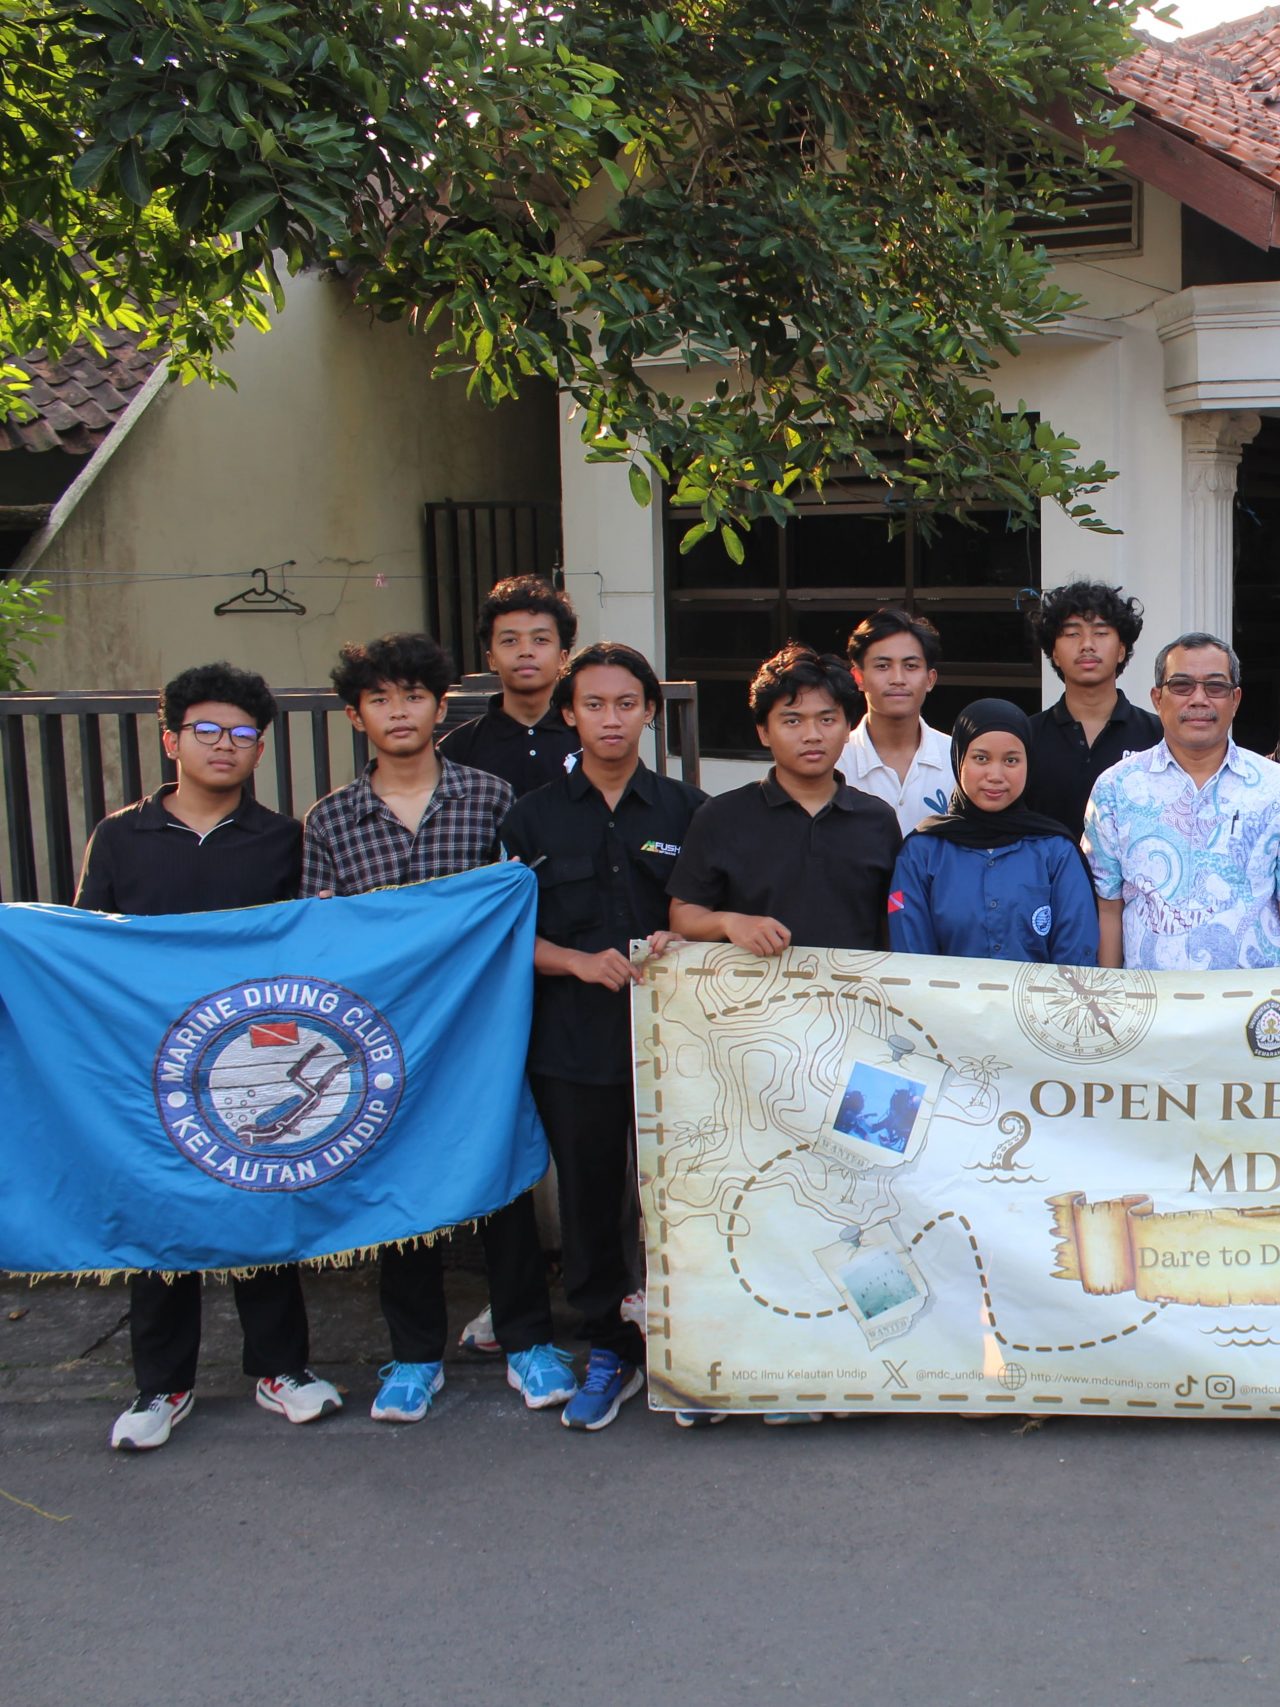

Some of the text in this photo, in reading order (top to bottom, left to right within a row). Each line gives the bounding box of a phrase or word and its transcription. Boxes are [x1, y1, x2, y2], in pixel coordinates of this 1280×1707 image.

[161, 983, 393, 1082] MARINE DIVING CLUB
[1029, 1078, 1198, 1121] OPEN
[172, 1099, 388, 1183] KELAUTAN UNDIP
[1138, 1244, 1211, 1270] Dare
[1218, 1245, 1252, 1266] to
[731, 1369, 758, 1380] MDC
[761, 1369, 784, 1380] Ilmu
[787, 1368, 834, 1380] Kelautan
[836, 1367, 868, 1381] Undip
[915, 1368, 985, 1382] @mdc_undip
[1030, 1372, 1170, 1390] http://www.mdcundip.com
